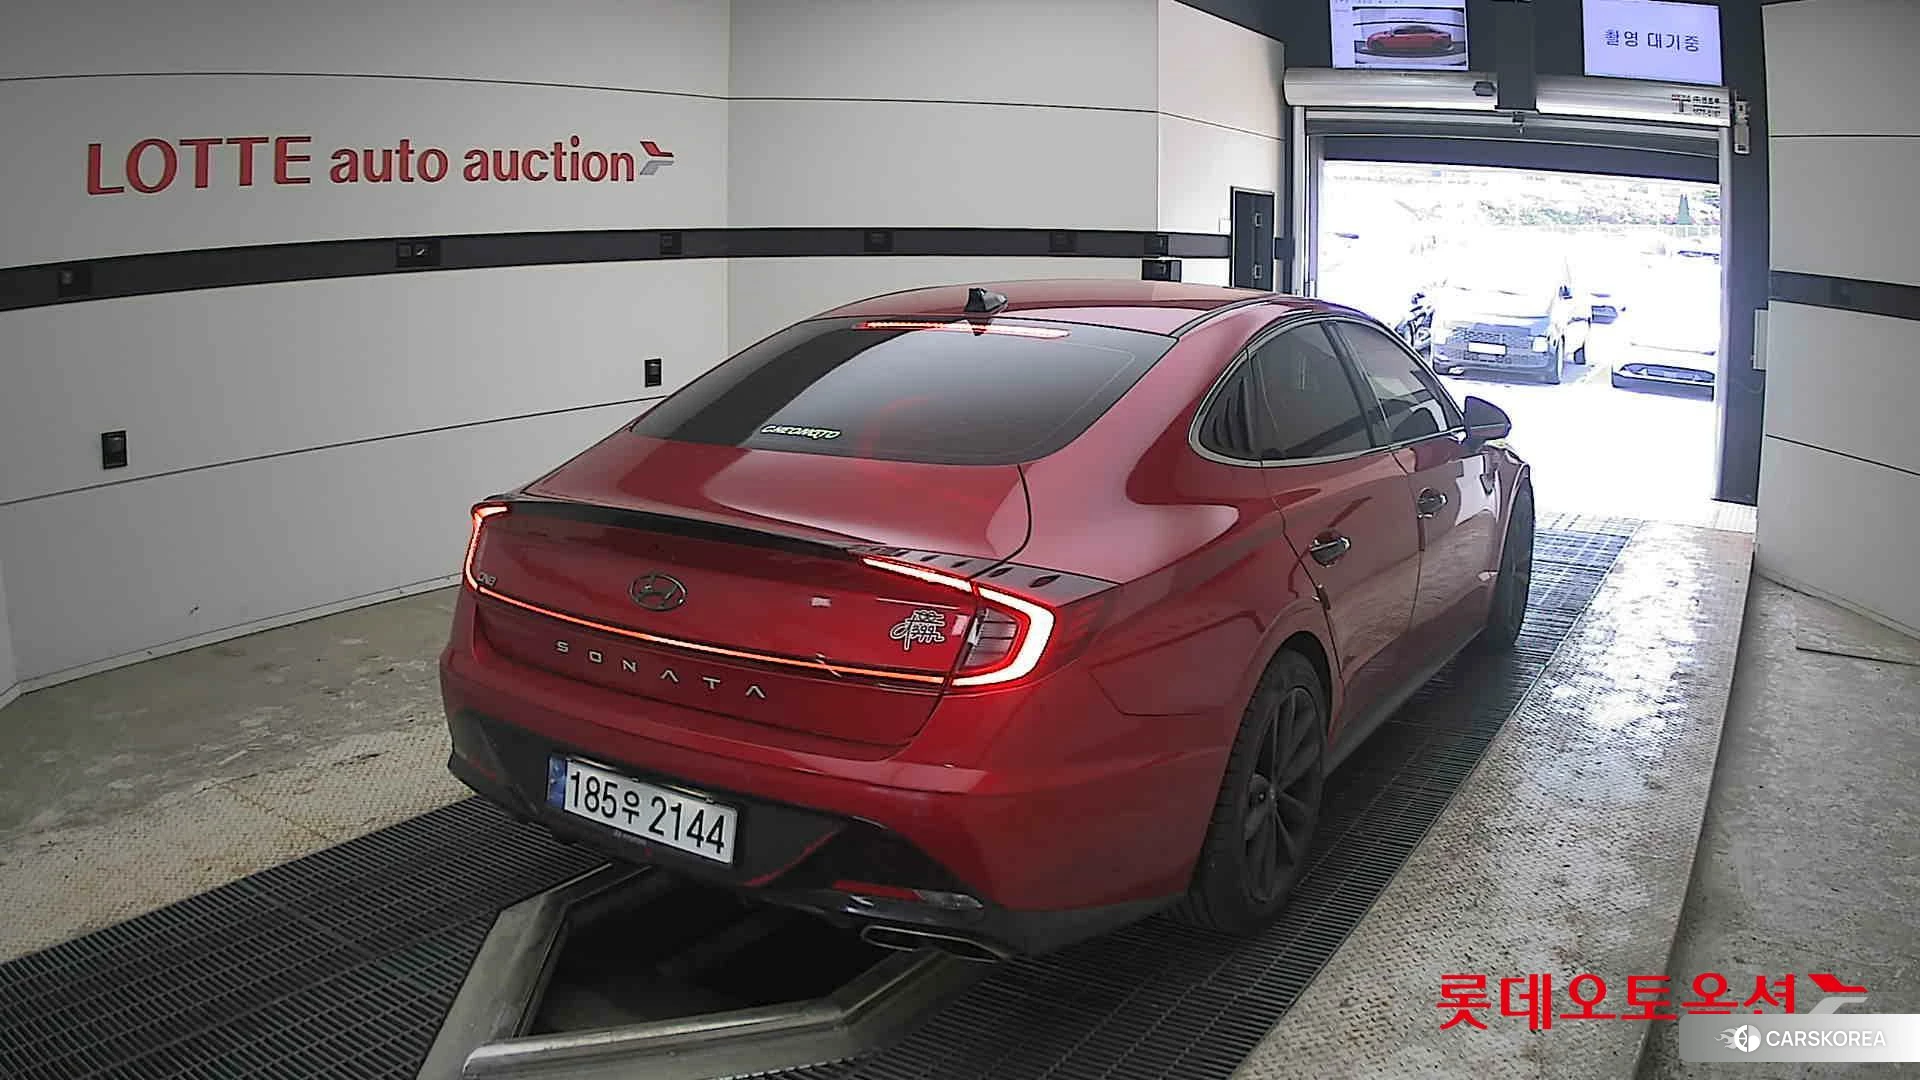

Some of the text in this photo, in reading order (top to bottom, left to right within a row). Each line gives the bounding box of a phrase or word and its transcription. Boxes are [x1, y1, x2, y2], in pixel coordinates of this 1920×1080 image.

[1646, 32, 1700, 52] 대기중
[87, 135, 635, 196] LOTTE auto auction
[555, 640, 767, 699] SONATA
[569, 770, 726, 854] 185우 2144
